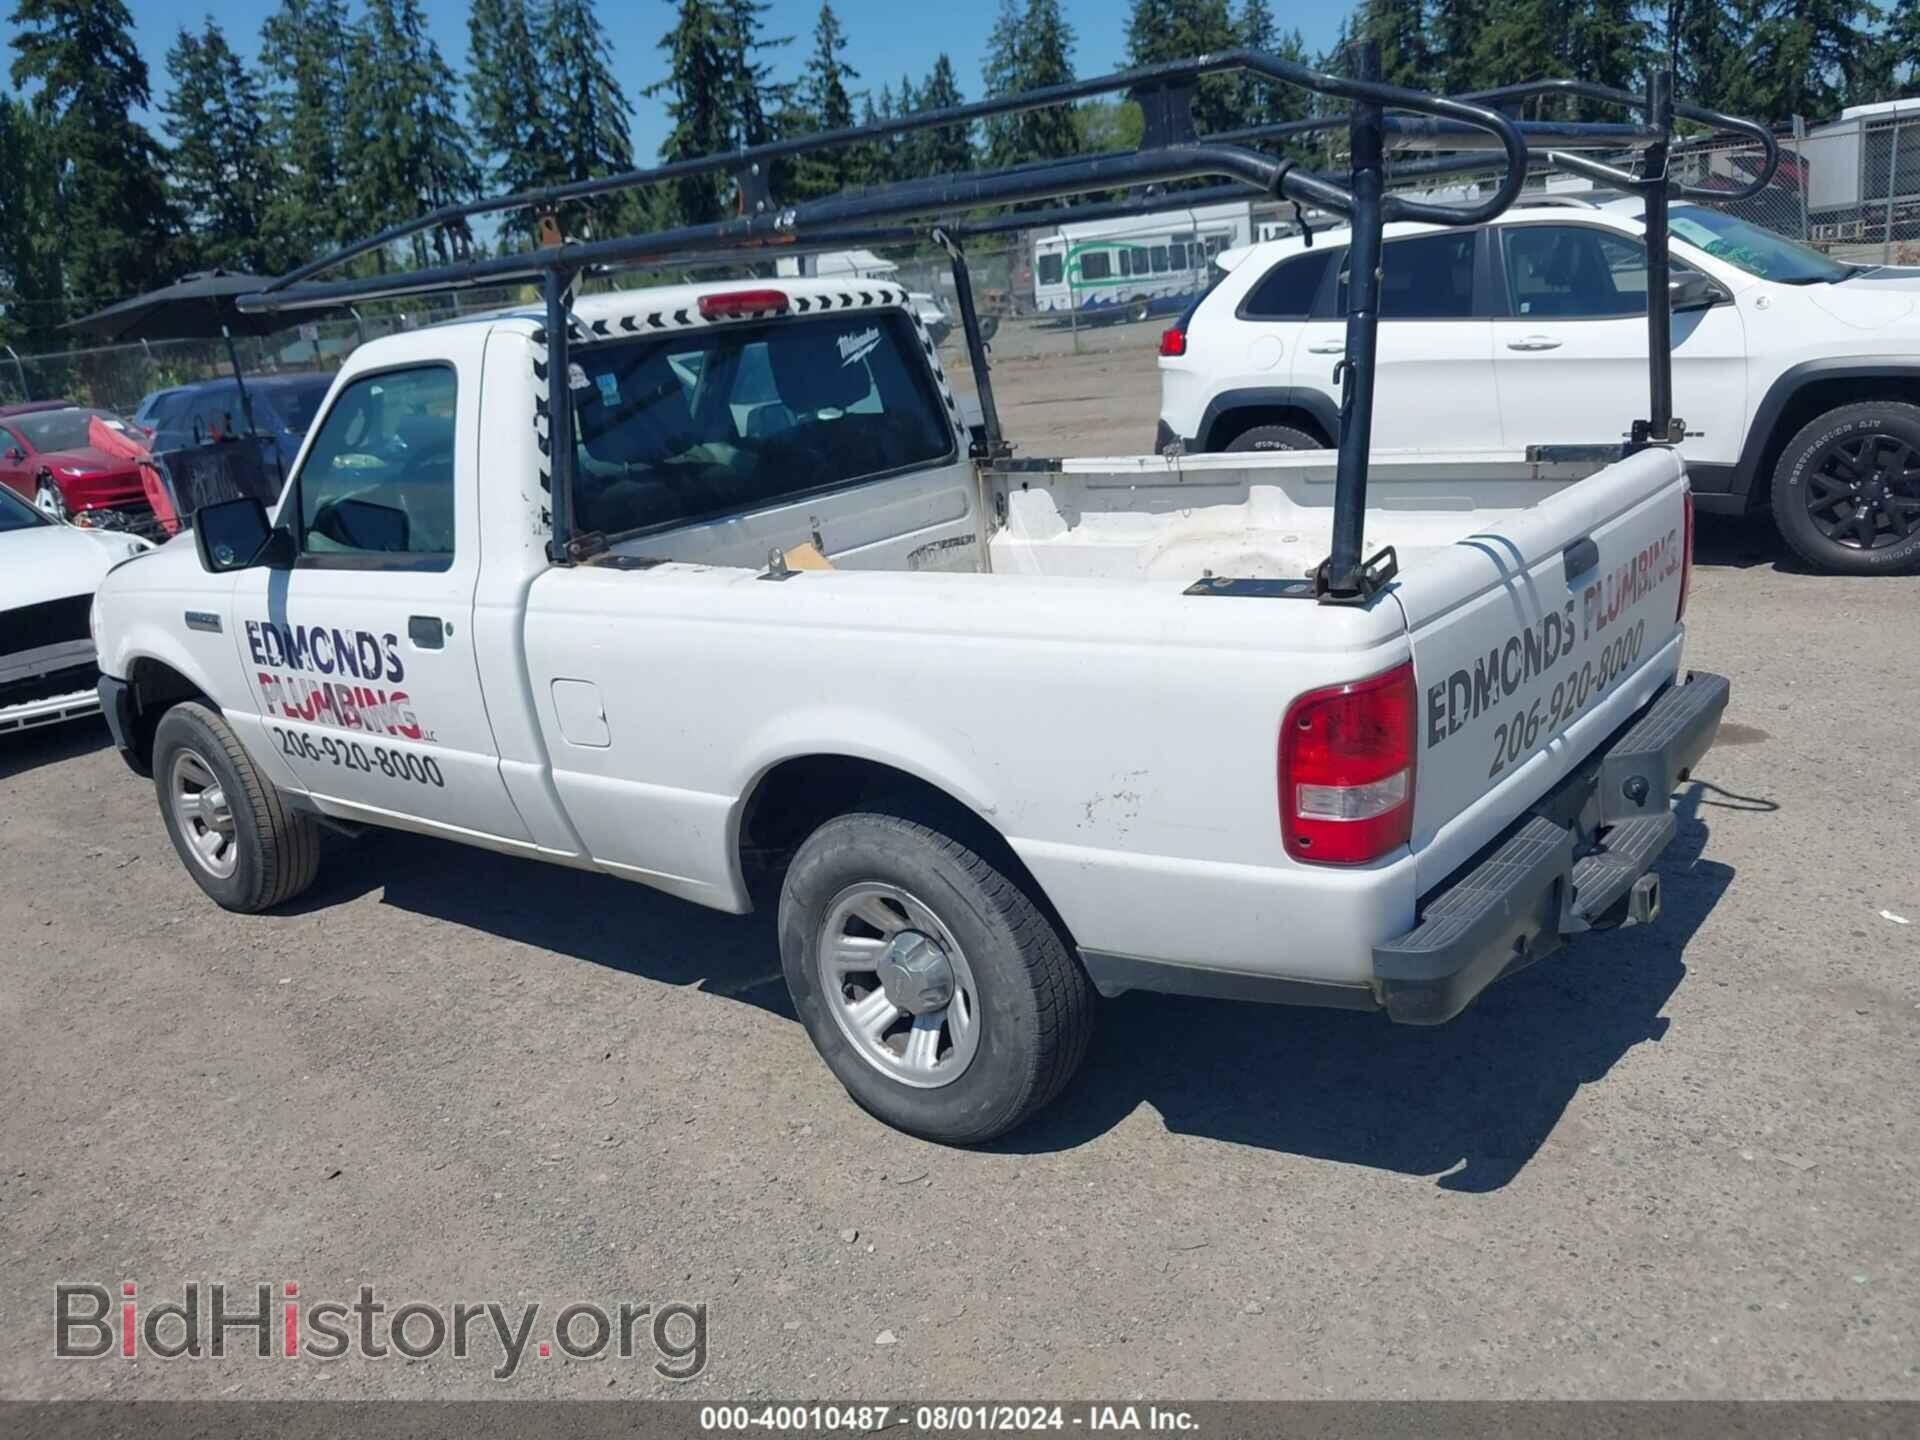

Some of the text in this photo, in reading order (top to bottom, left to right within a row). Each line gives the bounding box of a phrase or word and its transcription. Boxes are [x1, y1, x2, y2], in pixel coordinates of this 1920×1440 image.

[245, 620, 405, 683] EDMONDS
[1427, 600, 1576, 749] EDMONDS
[257, 672, 422, 740] PLUMBING
[1488, 619, 1645, 778] 206-920-8000
[273, 726, 445, 788] 206-920-8000
